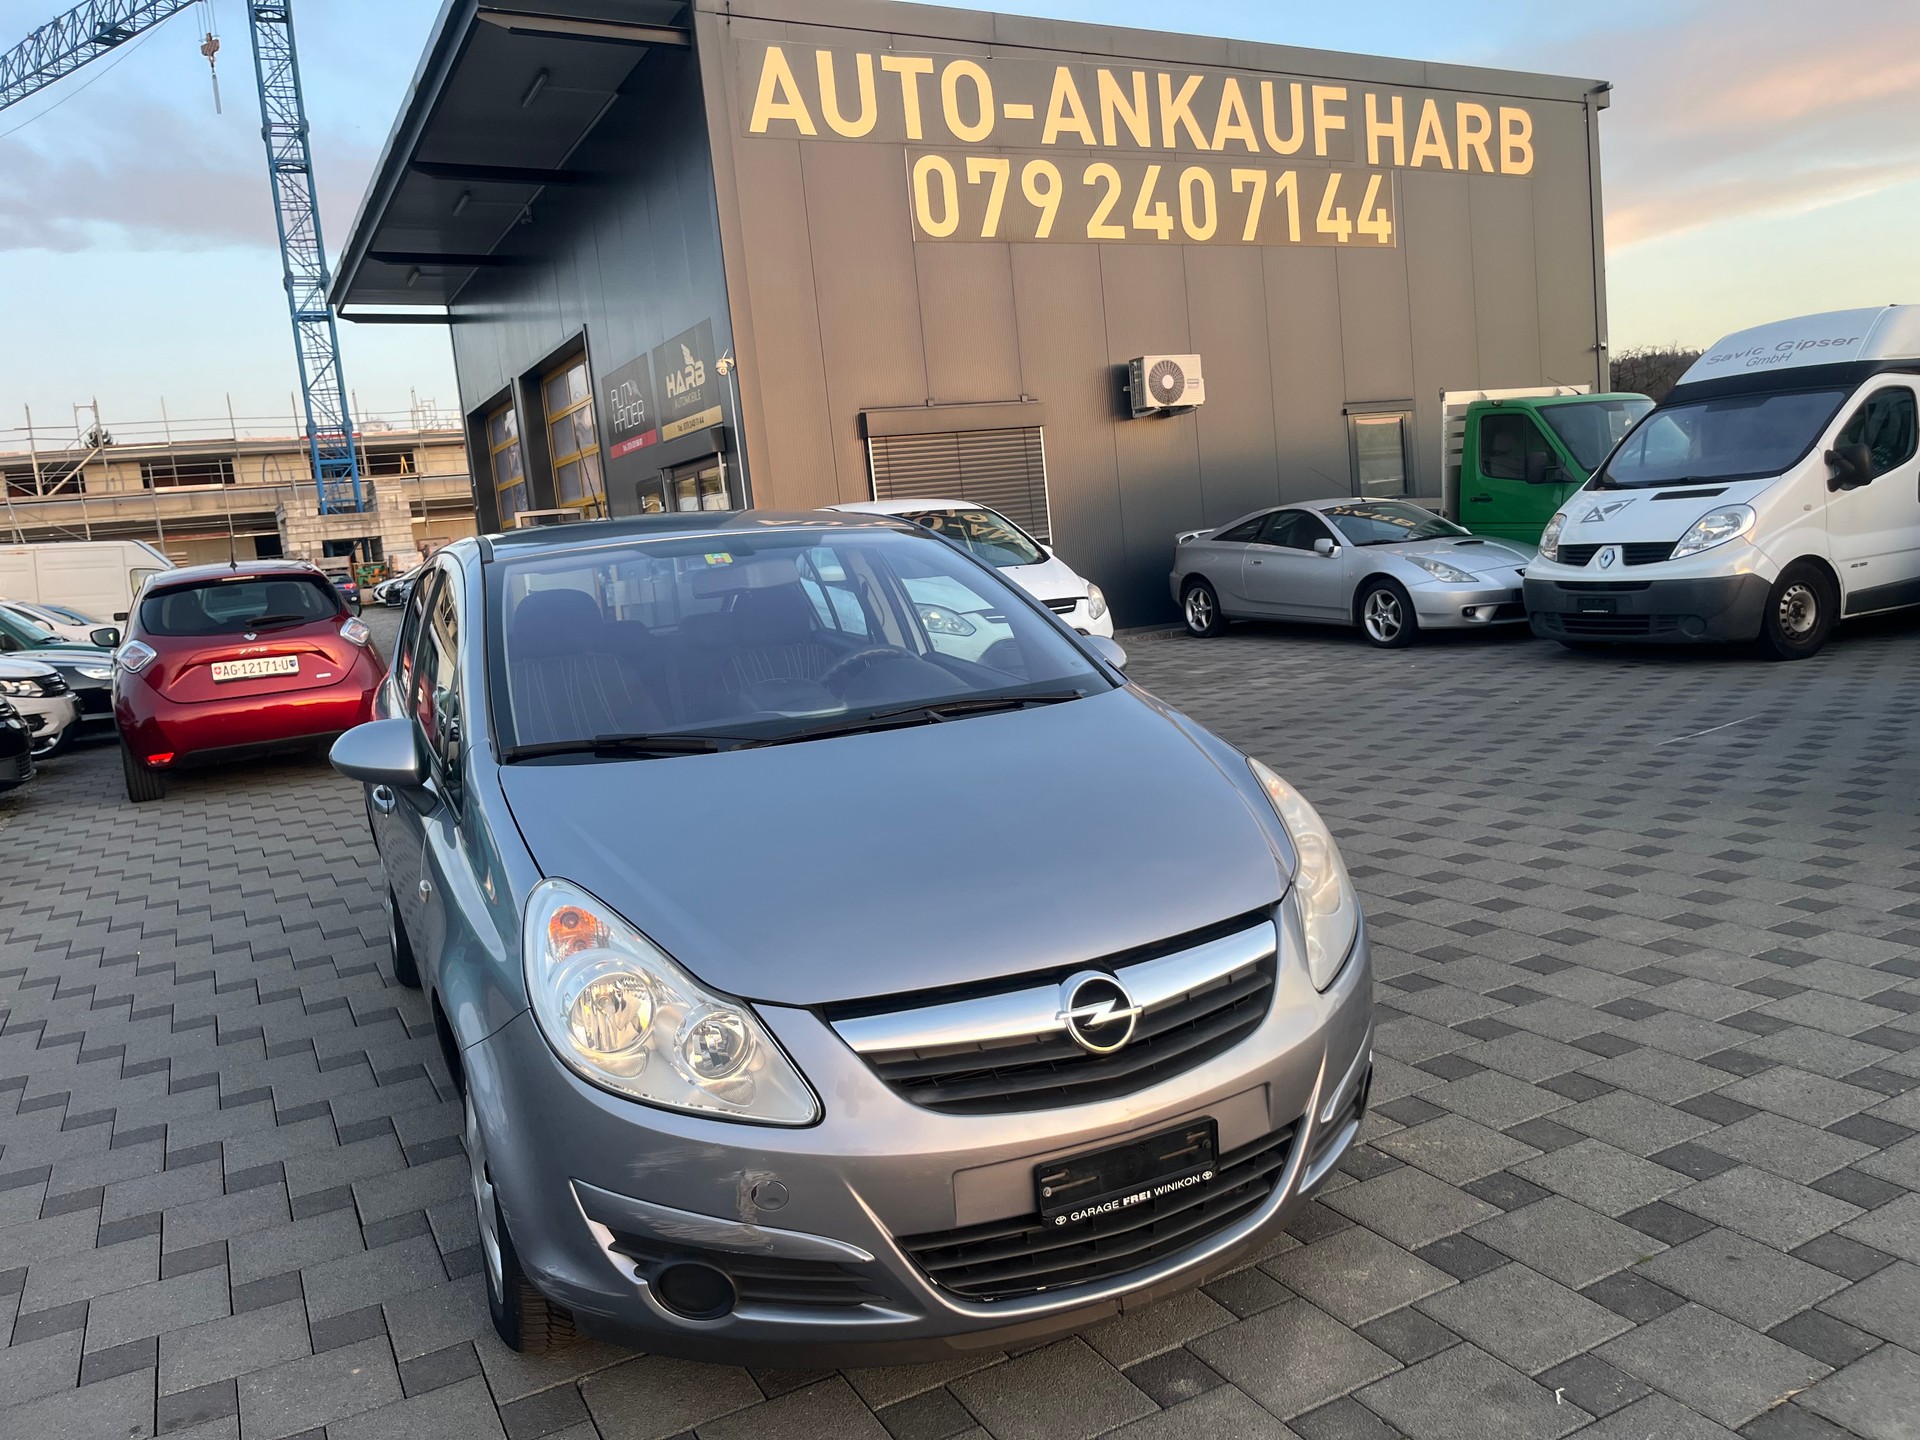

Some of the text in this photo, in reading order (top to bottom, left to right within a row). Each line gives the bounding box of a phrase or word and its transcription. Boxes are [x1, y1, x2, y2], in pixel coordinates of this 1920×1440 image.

[749, 46, 1534, 175] AUTO-ANKAUF HARB
[912, 154, 1392, 243] 079 240 71 44
[1706, 336, 1859, 365] Savic Gipser
[1746, 352, 1793, 367] GmbH
[666, 360, 705, 398] HARB
[1070, 1174, 1200, 1222] GARAGE FREI WINIKON
